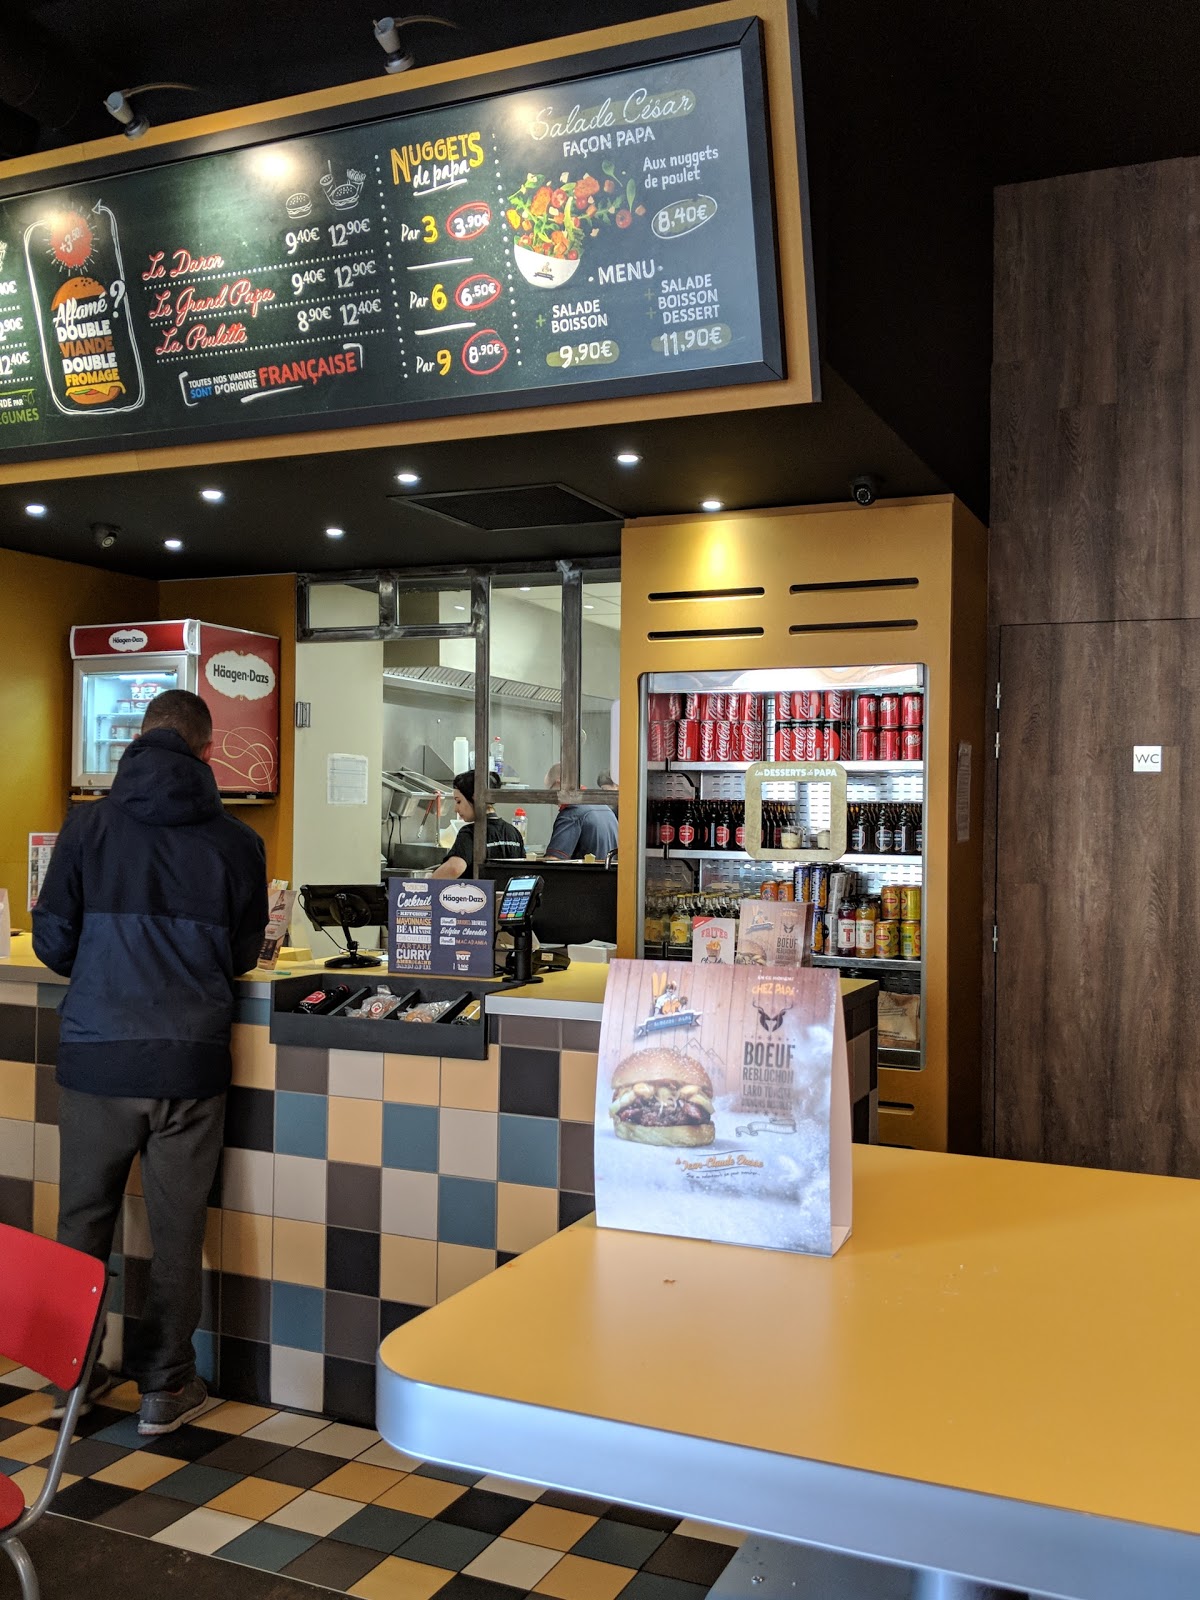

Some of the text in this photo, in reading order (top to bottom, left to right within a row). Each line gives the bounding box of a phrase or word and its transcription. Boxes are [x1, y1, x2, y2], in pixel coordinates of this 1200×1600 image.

[530, 88, 694, 140] Salade César
[563, 126, 656, 158] FAÇON PAPA
[390, 132, 484, 185] NUGGETS
[643, 145, 718, 172] Aux nuggets
[413, 160, 470, 188] de papa
[644, 165, 700, 190] de poulet
[401, 223, 420, 242] Par
[422, 216, 438, 243] 3
[658, 204, 707, 232] 8,40€
[142, 251, 166, 280] Le
[170, 248, 224, 278] Daron
[598, 260, 655, 285] MENU
[661, 274, 712, 294] SALADE
[53, 280, 125, 328] Affamé ?
[149, 290, 172, 320] Le
[176, 284, 228, 327] Grand
[228, 278, 276, 318] Papa
[410, 291, 428, 309] Par
[432, 284, 448, 310] 6
[552, 300, 600, 318] SALADE
[658, 289, 718, 310] BOISSON
[552, 314, 608, 334] BOISSON
[663, 304, 720, 324] DESSERT
[56, 320, 112, 342] DOUBLE
[156, 327, 183, 355] La
[186, 322, 248, 350] Poulette
[660, 326, 722, 356] 11,90€
[59, 336, 114, 358] VIANDE
[560, 340, 612, 368] 9,90€
[62, 353, 118, 374] DOUBLE
[258, 352, 357, 387] FRANÇAISE
[416, 356, 435, 373] Par
[436, 350, 451, 376] 9
[66, 368, 120, 386] FROMAGE
[188, 370, 256, 388] TOUTES NOS VIANDES
[190, 379, 258, 398] SONT D'ORIGINE
[0, 408, 40, 425] GUMES
[1136, 754, 1160, 764] WC
[397, 892, 432, 908] Cocktail
[701, 927, 728, 939] FRITES
[776, 937, 798, 948] BOEUF
[396, 949, 431, 960] CURRY
[744, 1041, 796, 1069] BOEUF
[743, 1067, 794, 1084] REBLOCHON
